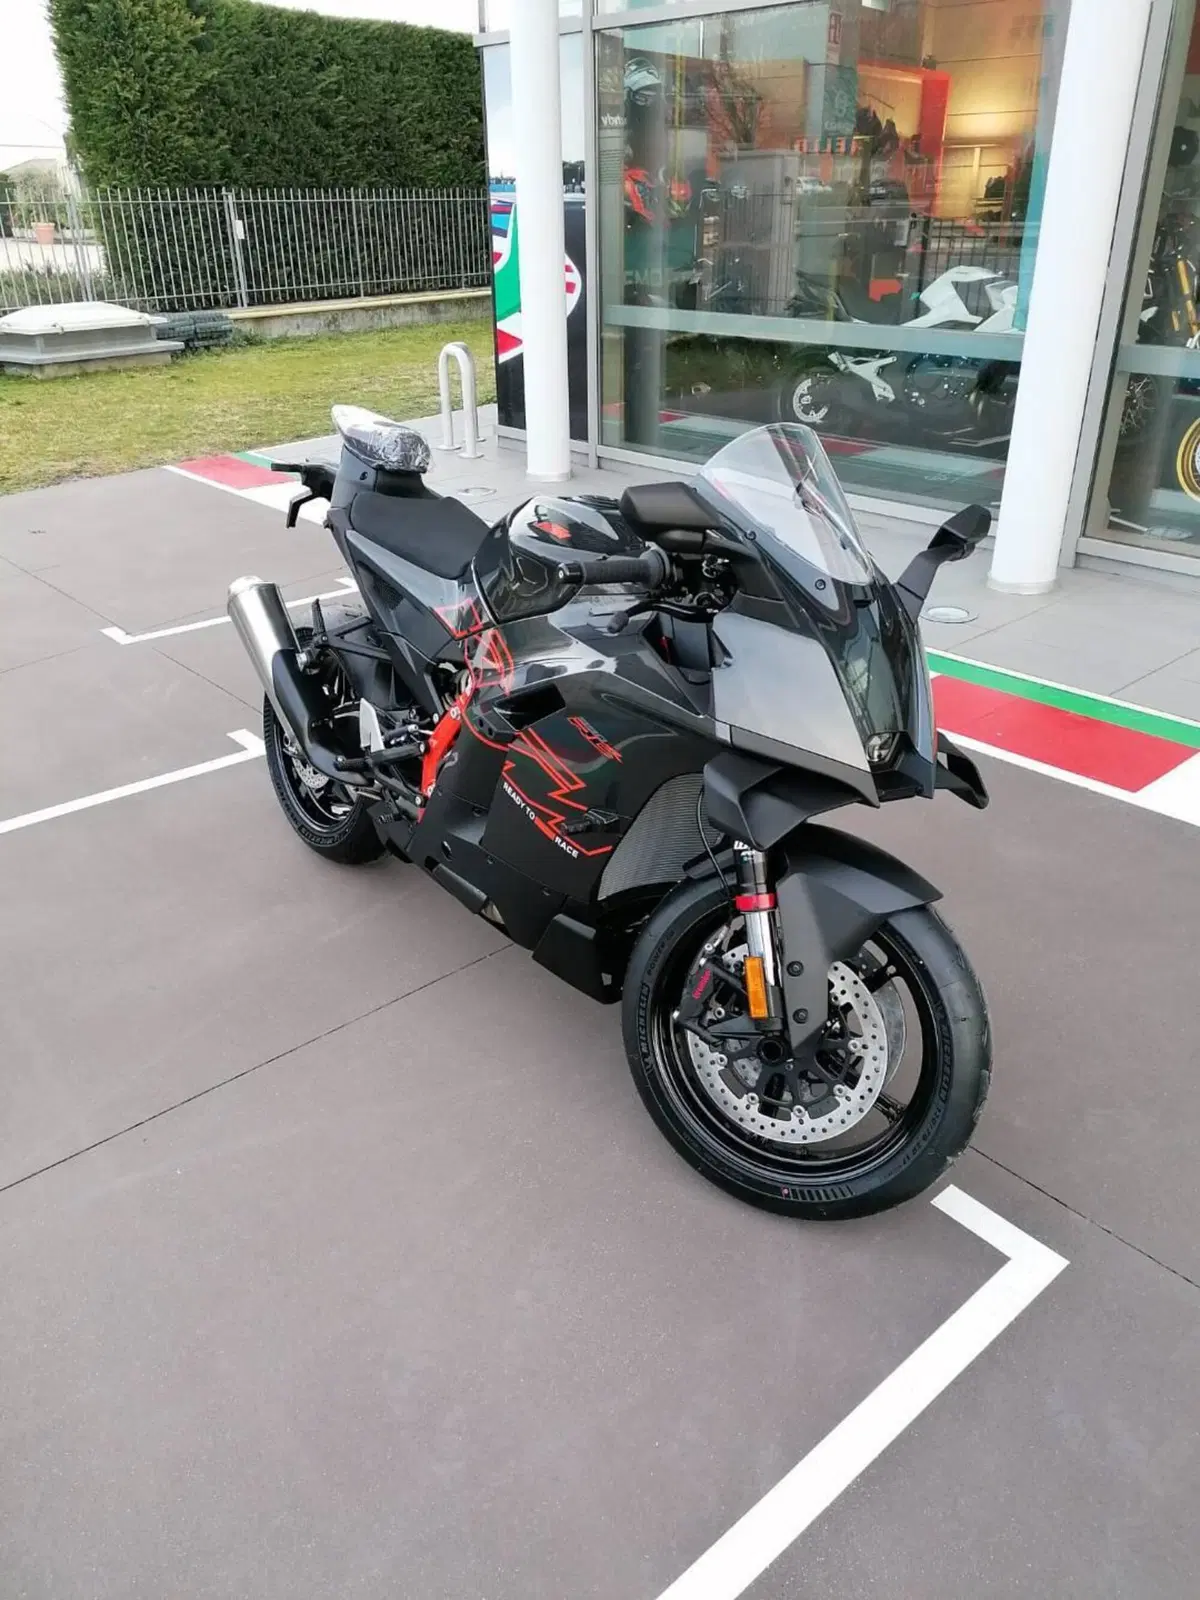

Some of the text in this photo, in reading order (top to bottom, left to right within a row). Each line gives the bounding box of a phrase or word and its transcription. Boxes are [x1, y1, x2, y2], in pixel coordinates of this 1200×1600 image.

[503, 782, 579, 859] READY TO RACE
[640, 983, 651, 1056] MICHELIN
